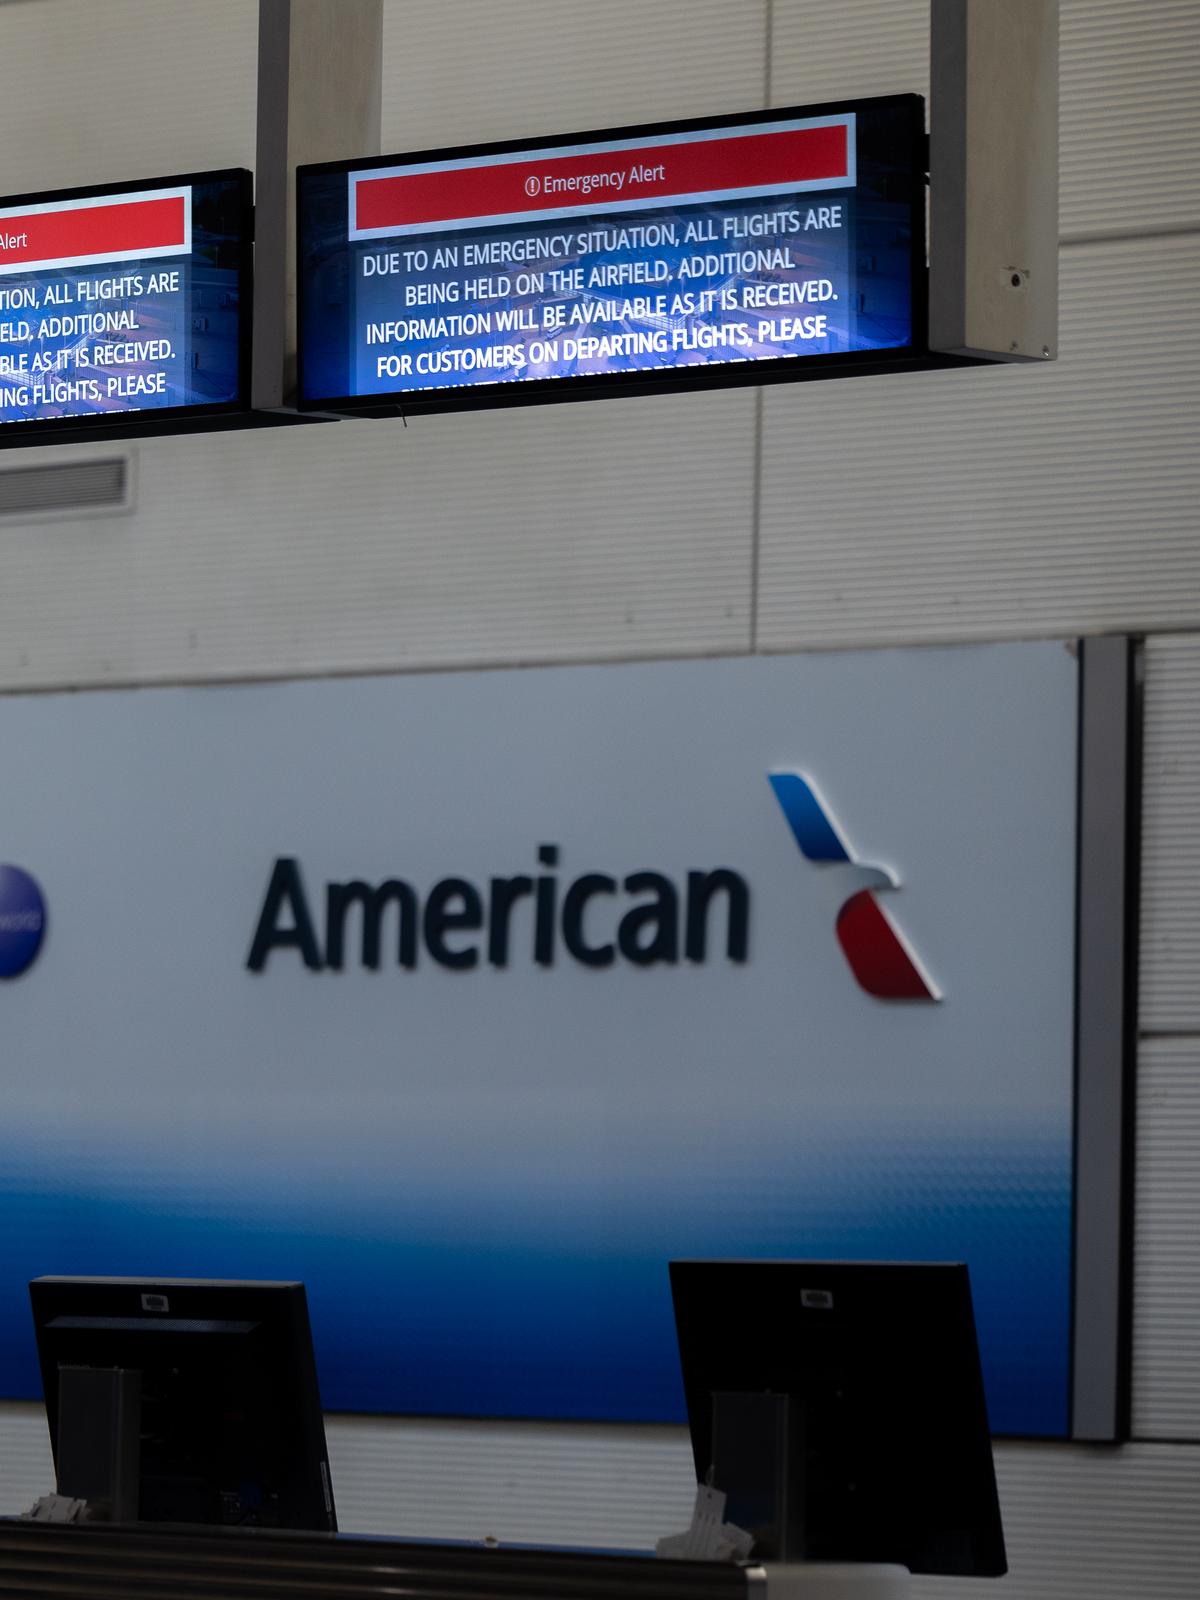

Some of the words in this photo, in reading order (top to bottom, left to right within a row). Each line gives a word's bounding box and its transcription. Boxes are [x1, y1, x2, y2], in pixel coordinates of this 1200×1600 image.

[543, 167, 625, 194] Emergency
[629, 163, 665, 184] Alert
[362, 252, 399, 276] DUE
[402, 249, 427, 272] TO
[432, 246, 458, 269] AN
[463, 234, 573, 266] EMERGENCY
[577, 223, 679, 254] SITUATION,
[684, 219, 718, 243] ALL
[723, 210, 799, 239] FLIGHTS
[804, 206, 841, 231] ARE
[43, 283, 72, 305] ALL
[77, 275, 142, 302] FLIGHTS
[146, 271, 179, 294] ARE
[404, 280, 459, 306] BEING
[464, 275, 511, 300] HELD
[515, 272, 544, 295] ON
[548, 268, 584, 292] THE
[587, 259, 672, 288] AIRFIELD.
[677, 247, 795, 279] ADDITIONAL
[37, 309, 139, 339] ADDITIONAL
[366, 312, 490, 344] INFORMATION
[495, 307, 538, 332] WILL
[543, 305, 565, 328] BE
[569, 295, 666, 325] AVAILABLE
[670, 292, 694, 316] AS
[700, 290, 716, 313] IT
[721, 288, 737, 311] IS
[743, 279, 837, 309] RECEIVED.
[31, 351, 52, 372] AS
[56, 349, 71, 369] IT
[75, 347, 89, 368] IS
[94, 338, 175, 366] RECEIVED.
[376, 353, 411, 378] FOR
[415, 343, 524, 374] CUSTOMERS
[529, 340, 559, 364] ON
[563, 330, 667, 361] DEPARTING
[672, 322, 752, 351] FLIGHTS,
[757, 315, 826, 344] PLEASE
[32, 378, 102, 405] FLIGHTS,
[106, 372, 165, 398] PLEASE
[248, 845, 751, 969] American
